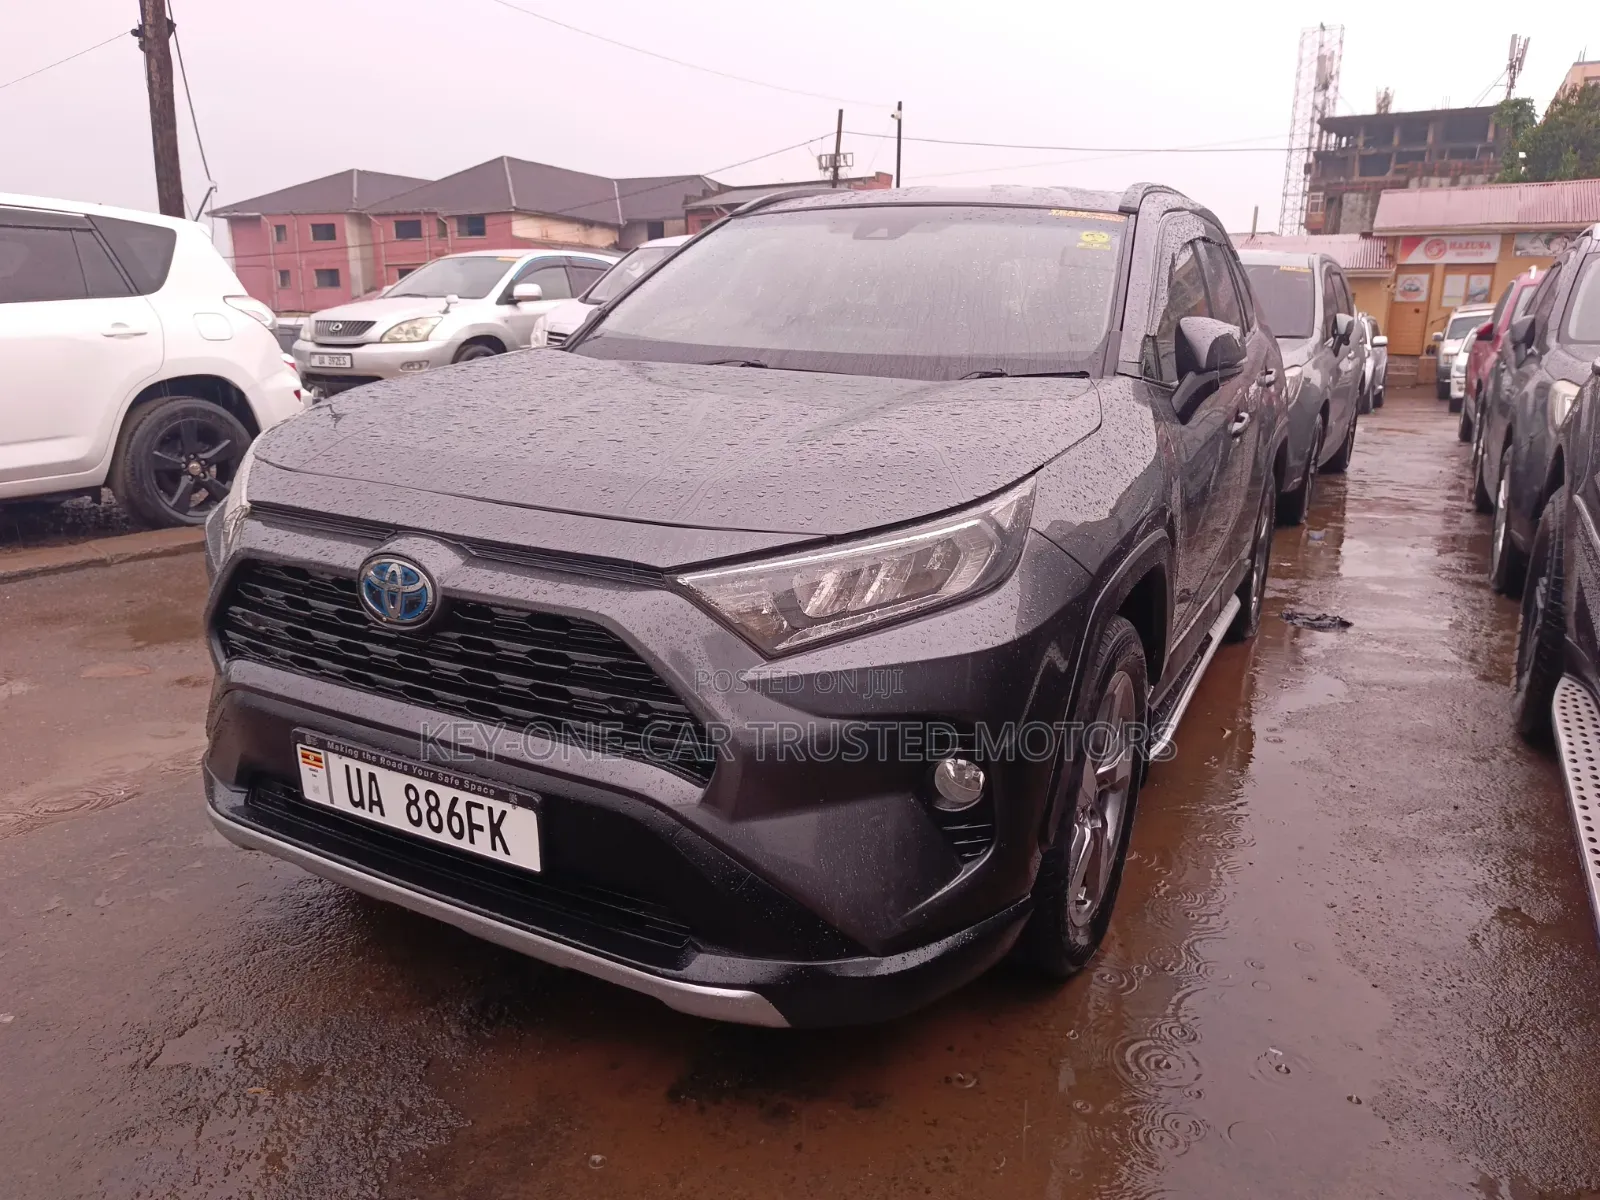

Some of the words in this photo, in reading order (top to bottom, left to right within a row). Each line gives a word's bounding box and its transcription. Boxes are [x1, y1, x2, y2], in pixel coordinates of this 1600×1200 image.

[327, 740, 359, 759] Making
[362, 751, 377, 763] the
[380, 756, 408, 772] Roads
[412, 765, 435, 778] Your
[438, 772, 460, 786] Safe
[464, 780, 496, 797] Space
[345, 764, 386, 818] UA
[404, 783, 511, 856] 886FK
